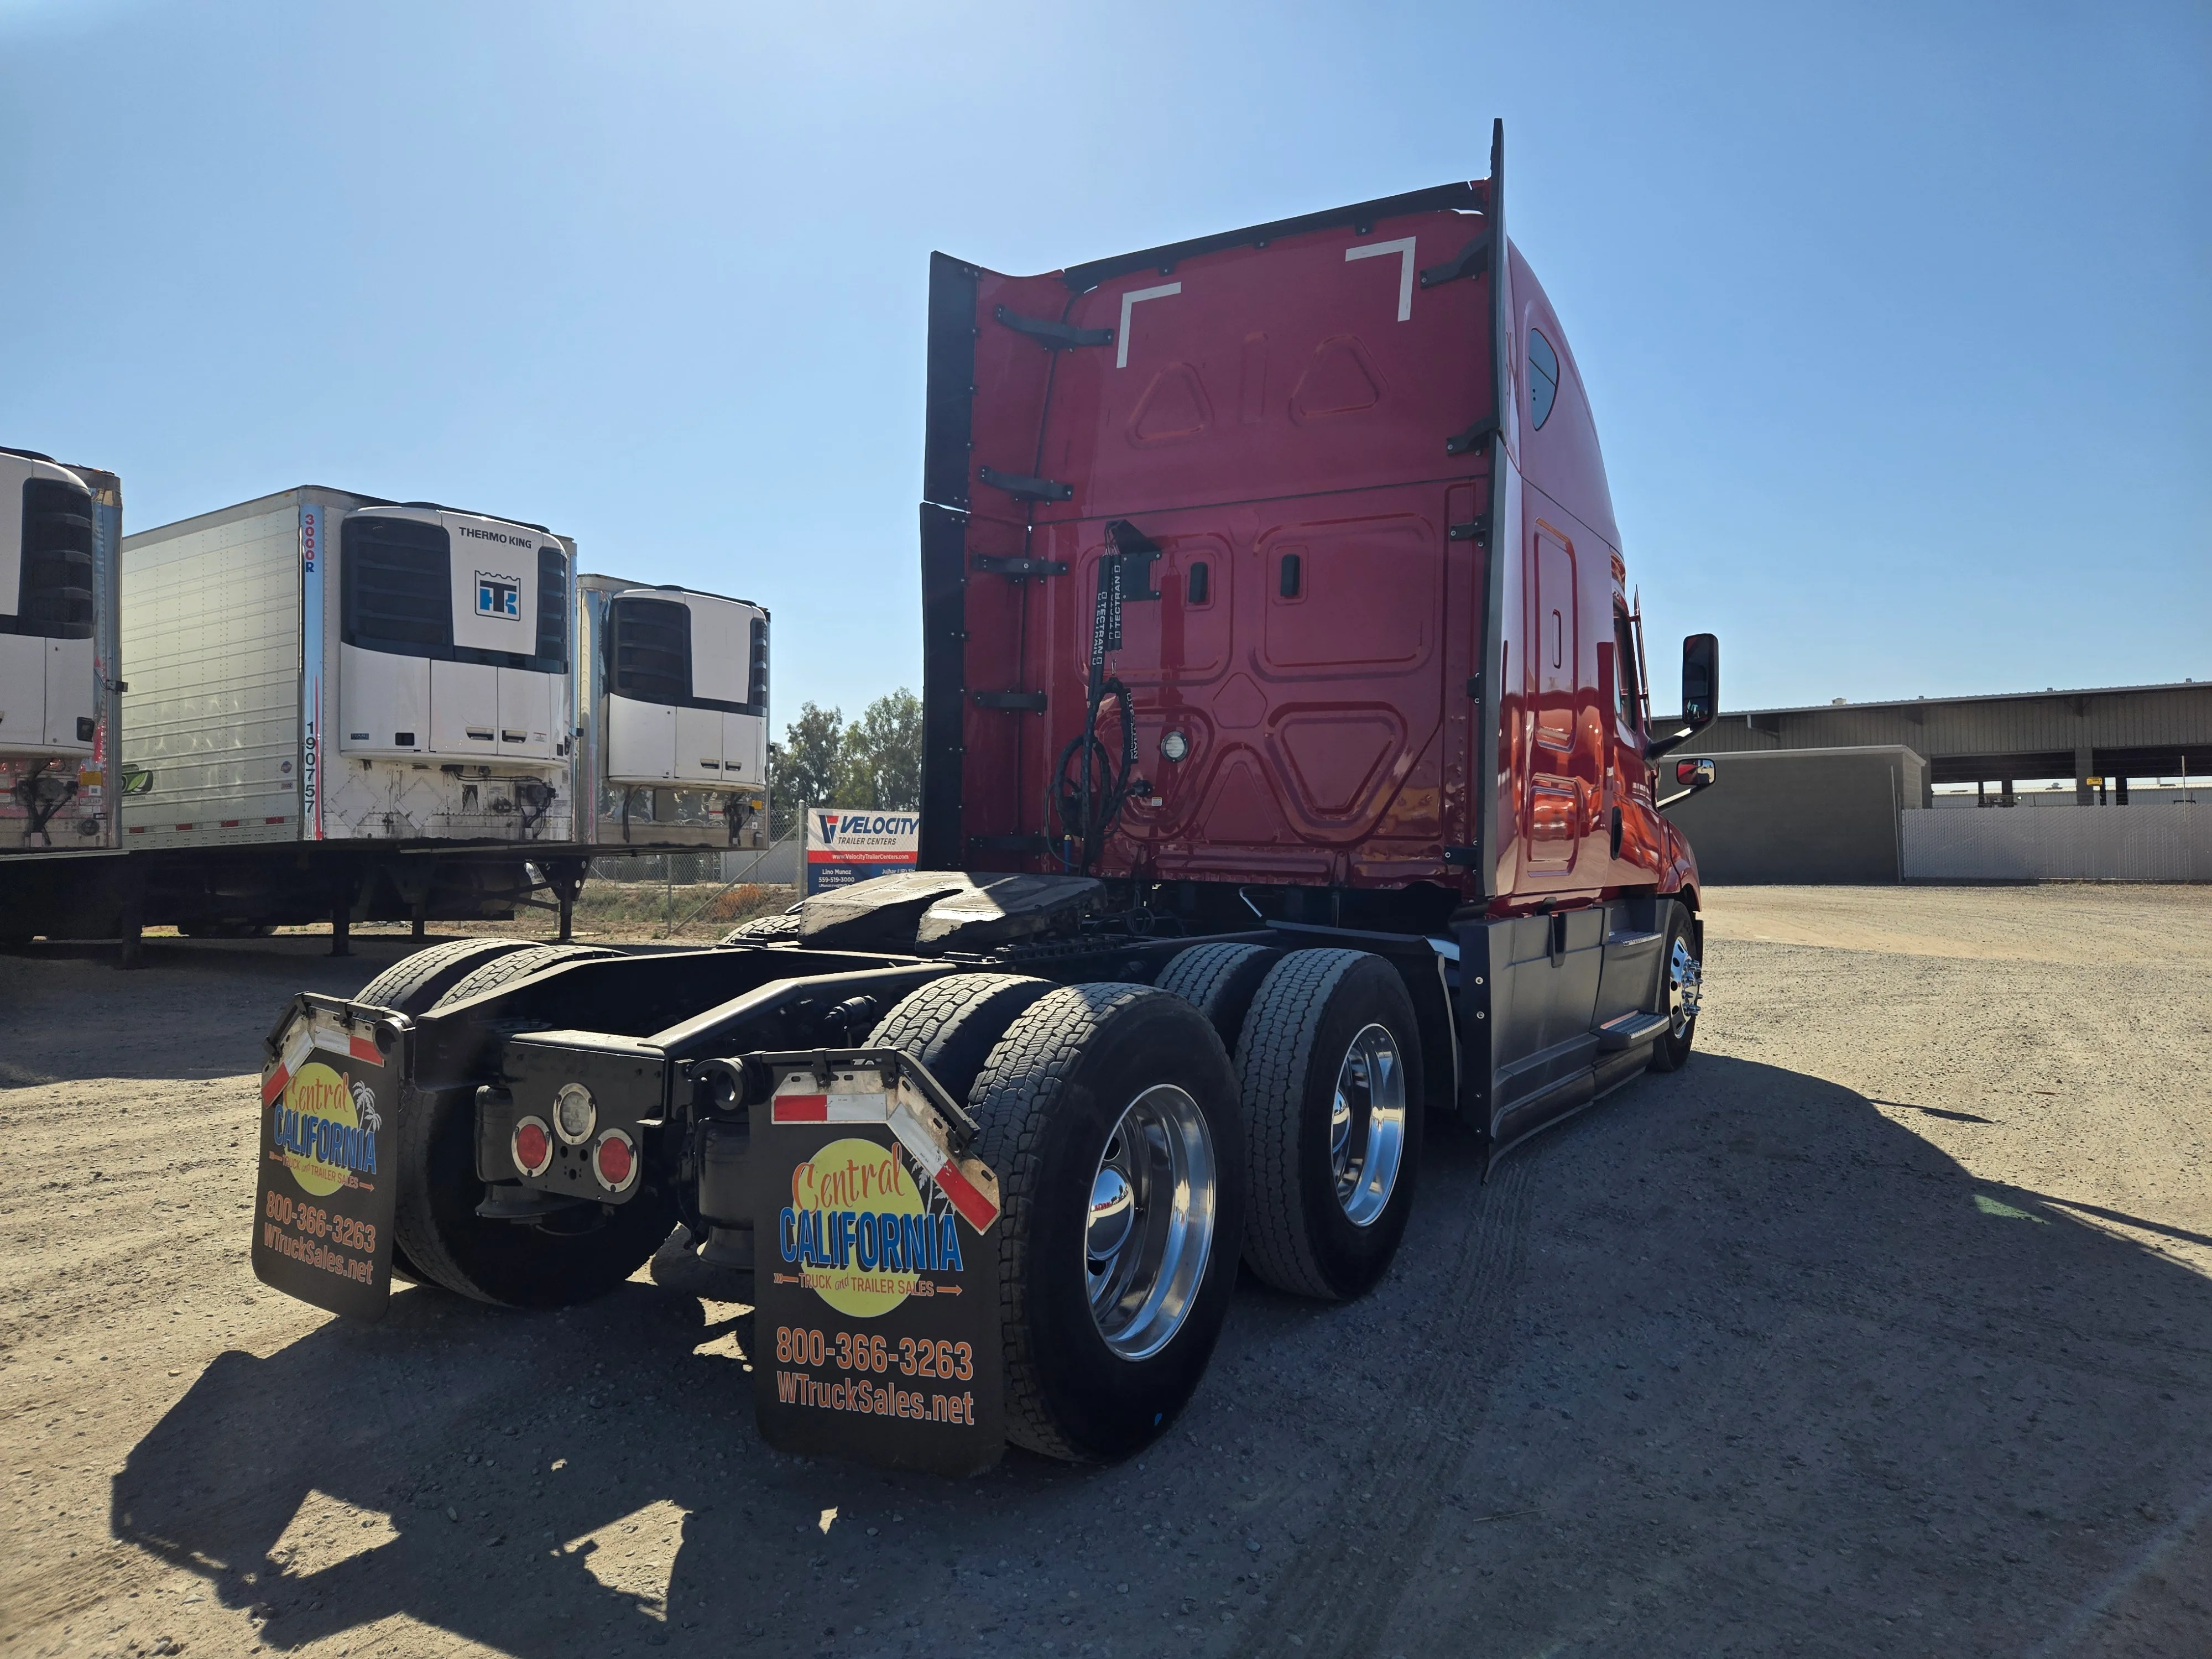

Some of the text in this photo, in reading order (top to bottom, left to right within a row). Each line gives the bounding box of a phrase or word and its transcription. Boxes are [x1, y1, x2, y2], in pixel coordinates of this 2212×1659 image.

[305, 514, 315, 573] 3000R
[459, 526, 532, 549] THERMO KING
[1098, 602, 1107, 654] TECTRAN
[305, 721, 316, 813] 190757
[840, 816, 919, 834] VELOCITY
[283, 1072, 349, 1114] Central
[274, 1104, 377, 1175] CALIFORNIA
[282, 1154, 359, 1189] TRUCK and TRAILER SALES
[792, 1141, 905, 1214] Central
[266, 1190, 376, 1253] 800-366-3263
[780, 1206, 964, 1272] CALIFORNIA
[264, 1222, 373, 1285] WTruckSales.net
[799, 1272, 935, 1297] TRUCK and TRAILER SALES
[776, 1326, 973, 1380] 800-366-3263
[776, 1370, 974, 1426] WTruckSales.net
